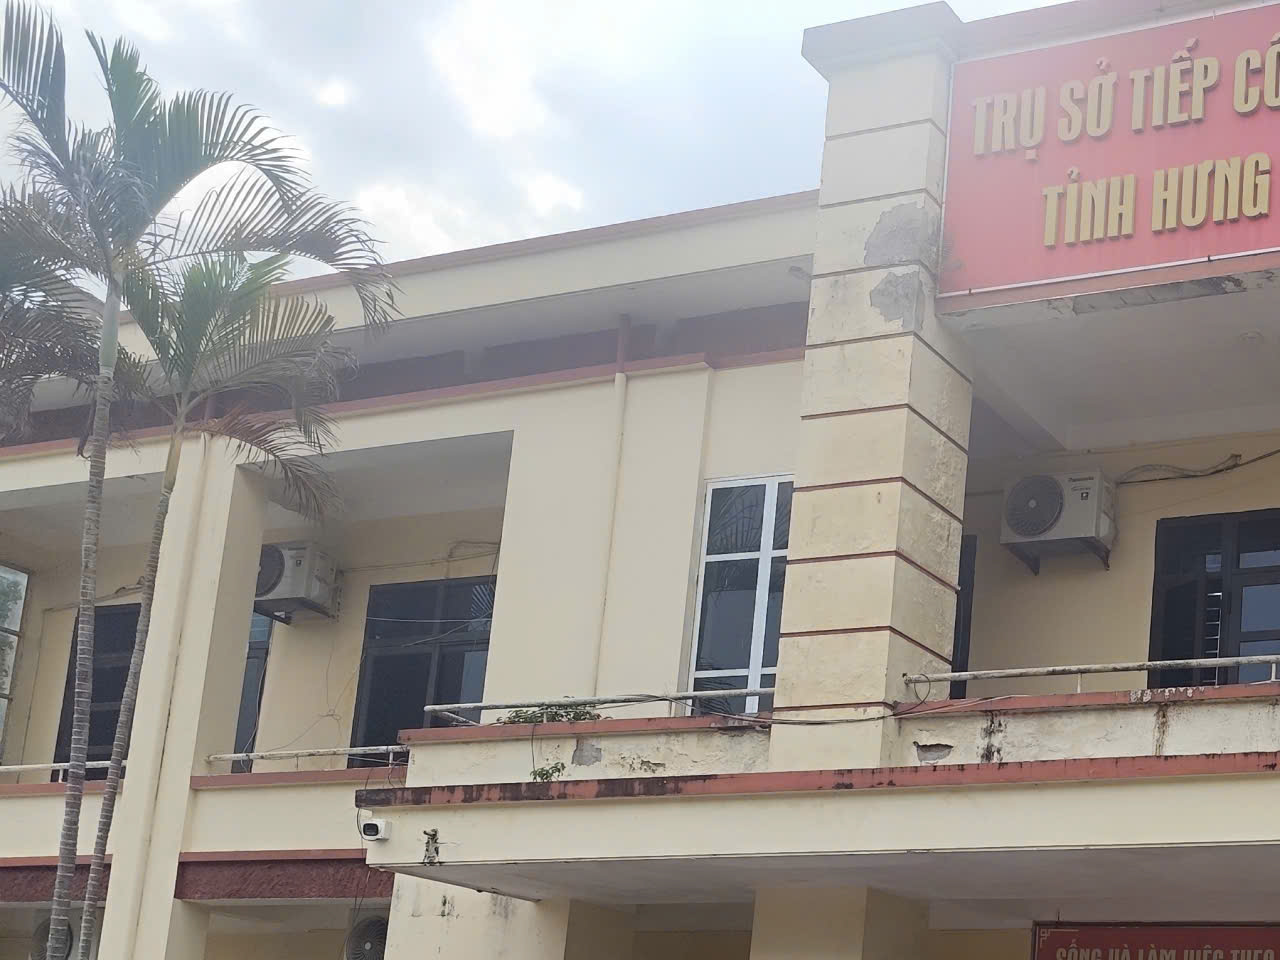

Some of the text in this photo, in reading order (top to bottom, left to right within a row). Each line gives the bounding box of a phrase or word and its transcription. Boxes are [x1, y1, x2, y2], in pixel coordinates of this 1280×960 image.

[970, 85, 1046, 162] TRỤ
[1057, 57, 1119, 143] SỞ
[1129, 37, 1220, 133] TIẾP
[1041, 166, 1136, 248] TỈNH
[1150, 151, 1272, 233] HƯNG
